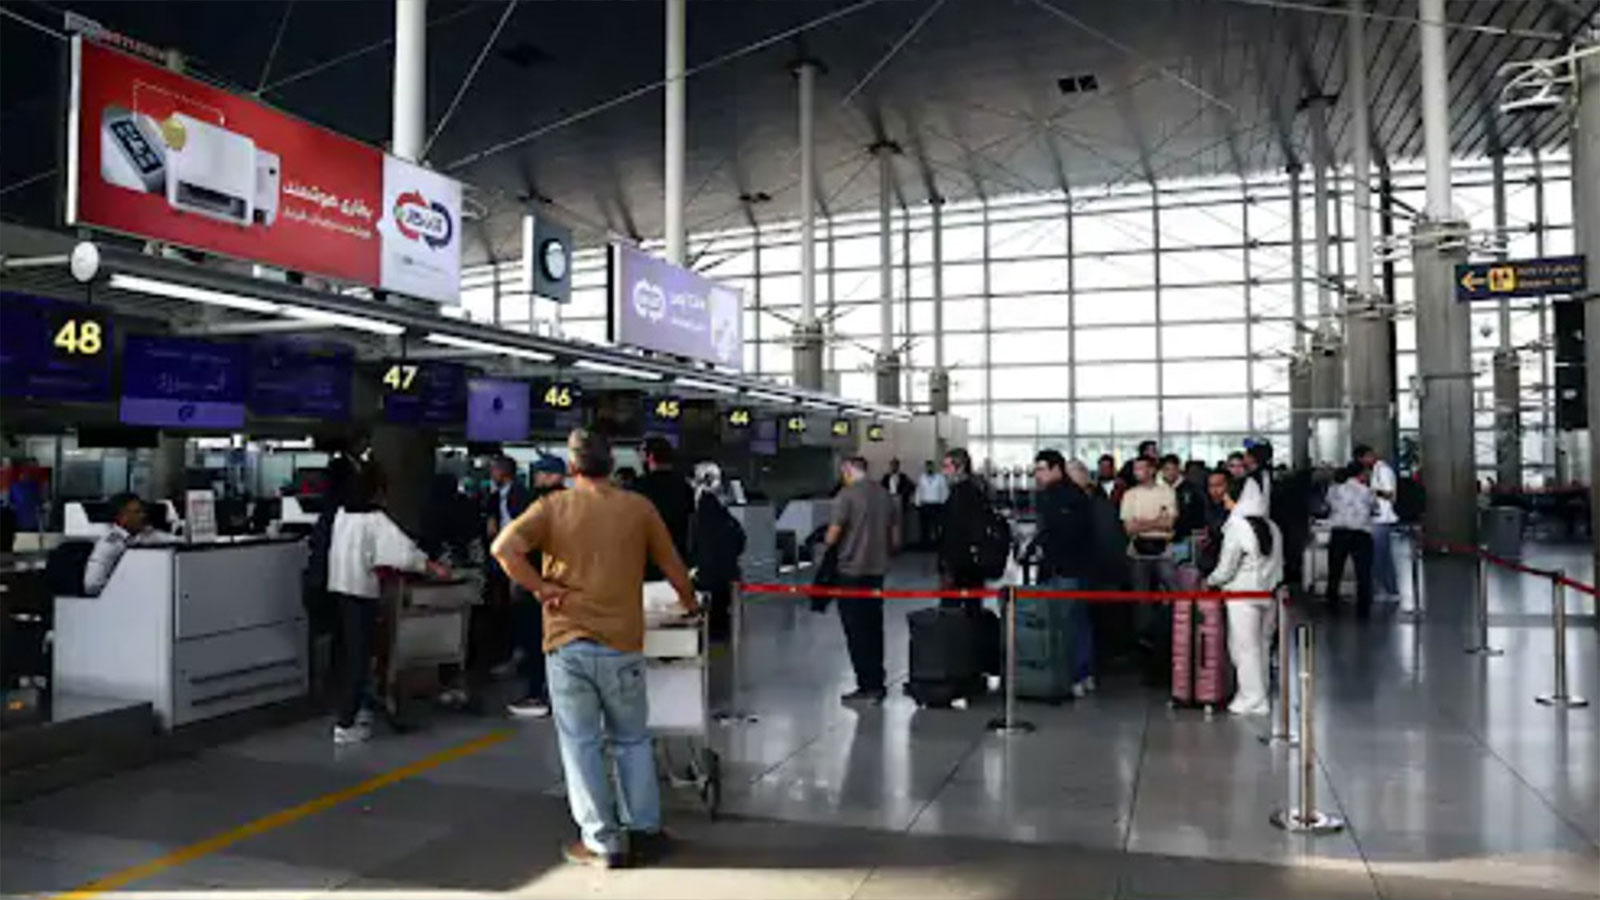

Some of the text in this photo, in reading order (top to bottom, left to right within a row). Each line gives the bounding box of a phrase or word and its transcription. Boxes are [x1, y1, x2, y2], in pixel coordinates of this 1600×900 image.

[54, 319, 102, 354] 48
[383, 365, 418, 390] 47
[544, 385, 572, 407] 46
[656, 400, 680, 418] 45
[729, 410, 749, 425] 44
